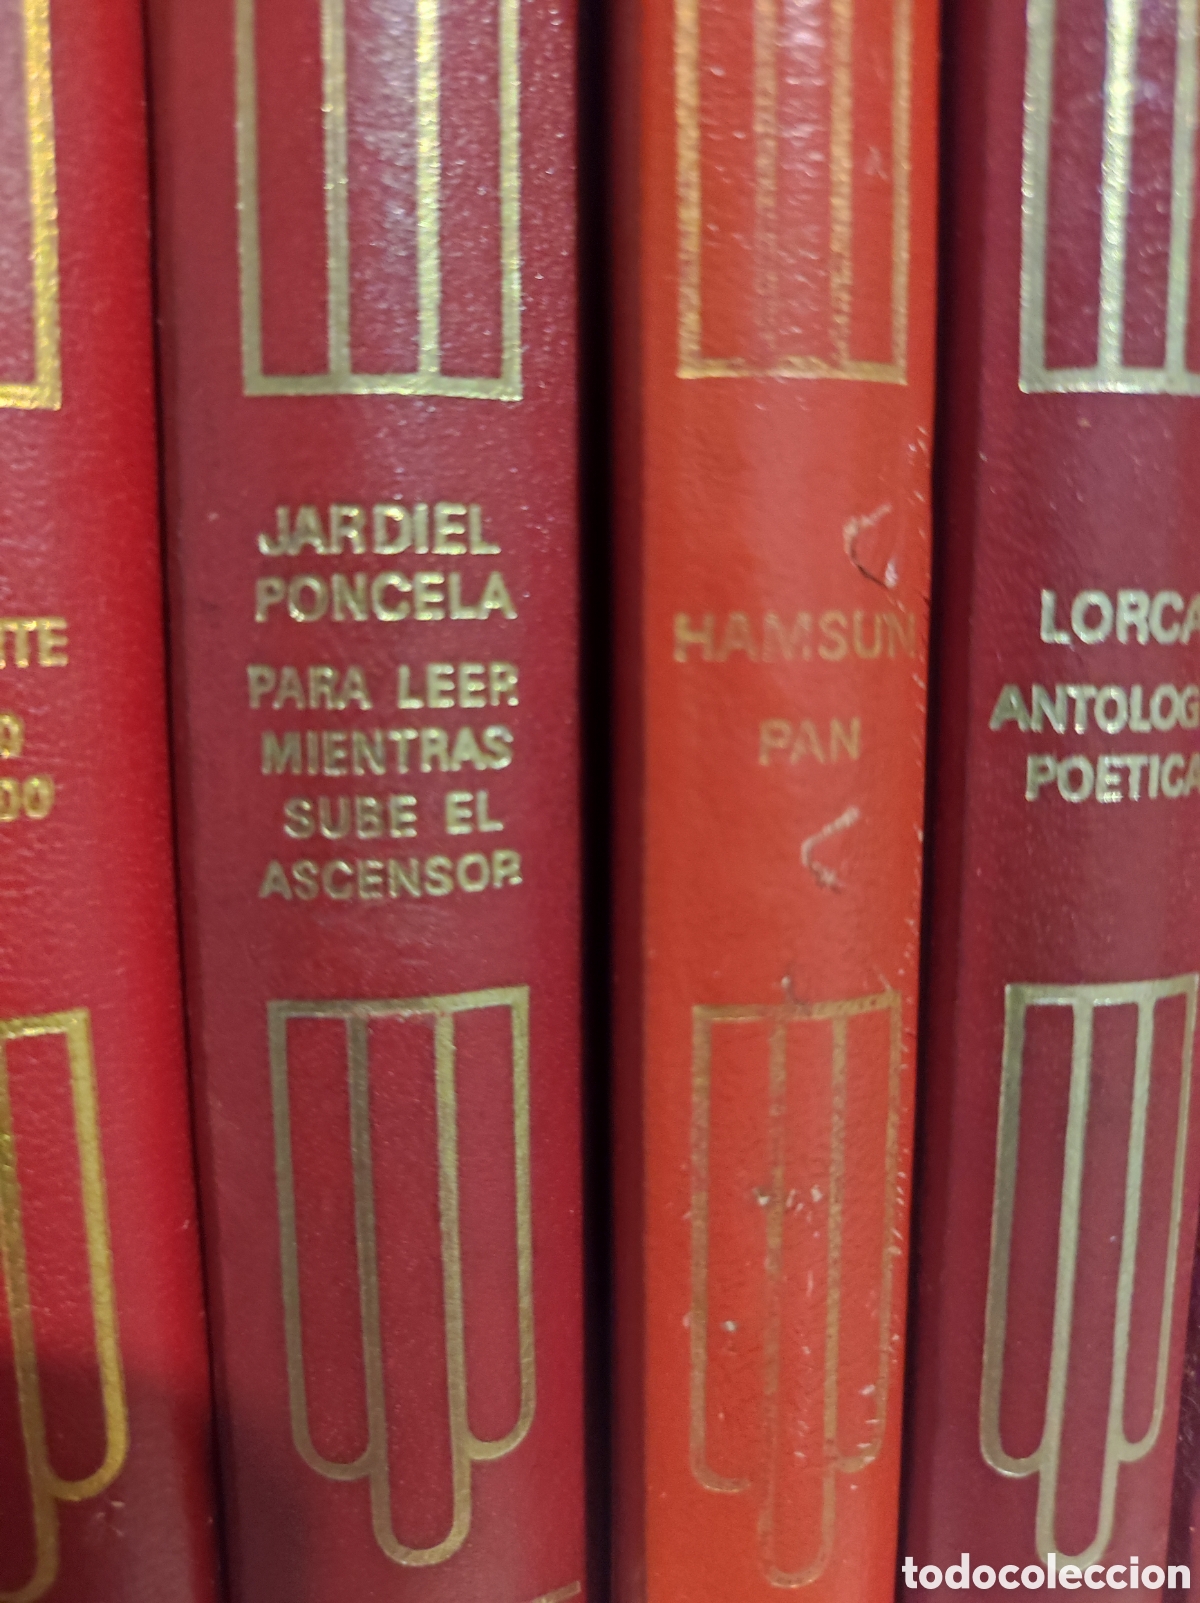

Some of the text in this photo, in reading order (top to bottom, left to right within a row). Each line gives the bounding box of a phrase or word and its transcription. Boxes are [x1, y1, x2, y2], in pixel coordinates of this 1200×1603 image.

[258, 503, 501, 556] JARDIEL
[254, 572, 518, 622] PONCELA
[1040, 588, 1200, 644] LORCA
[673, 608, 917, 663] HAMSUN
[247, 662, 519, 709] PARA LEER
[261, 726, 514, 776] MIENTRAS
[758, 717, 862, 766] PAN
[284, 791, 504, 839] SUBE EL
[259, 850, 523, 899] ASCENSOR
